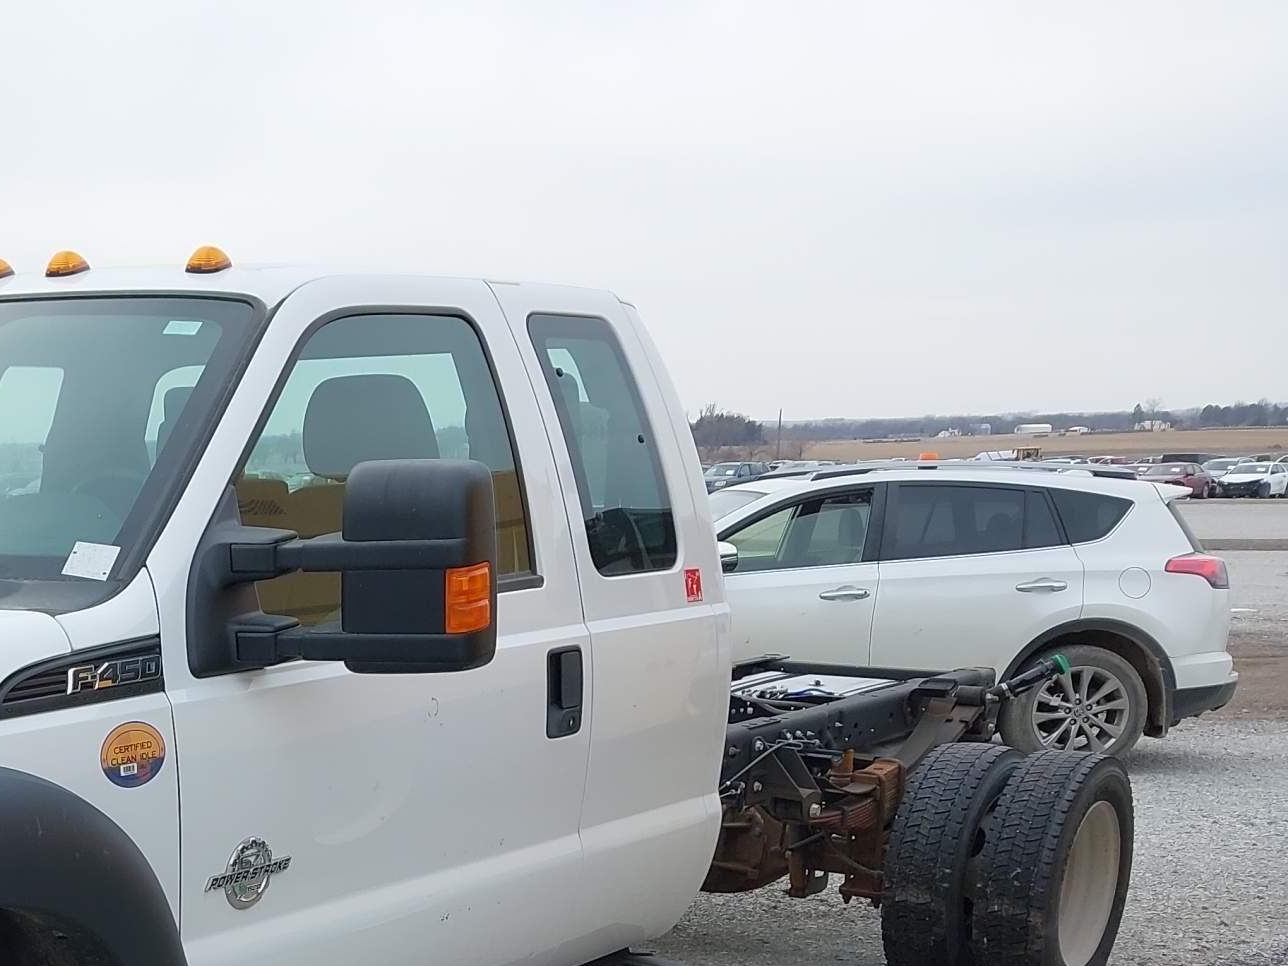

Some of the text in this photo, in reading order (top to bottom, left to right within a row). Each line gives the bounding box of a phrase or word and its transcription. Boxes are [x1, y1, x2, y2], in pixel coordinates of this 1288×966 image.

[67, 655, 161, 695] F-450
[114, 741, 153, 755] CERTIFIED
[110, 751, 158, 767] CLEAN IDLE
